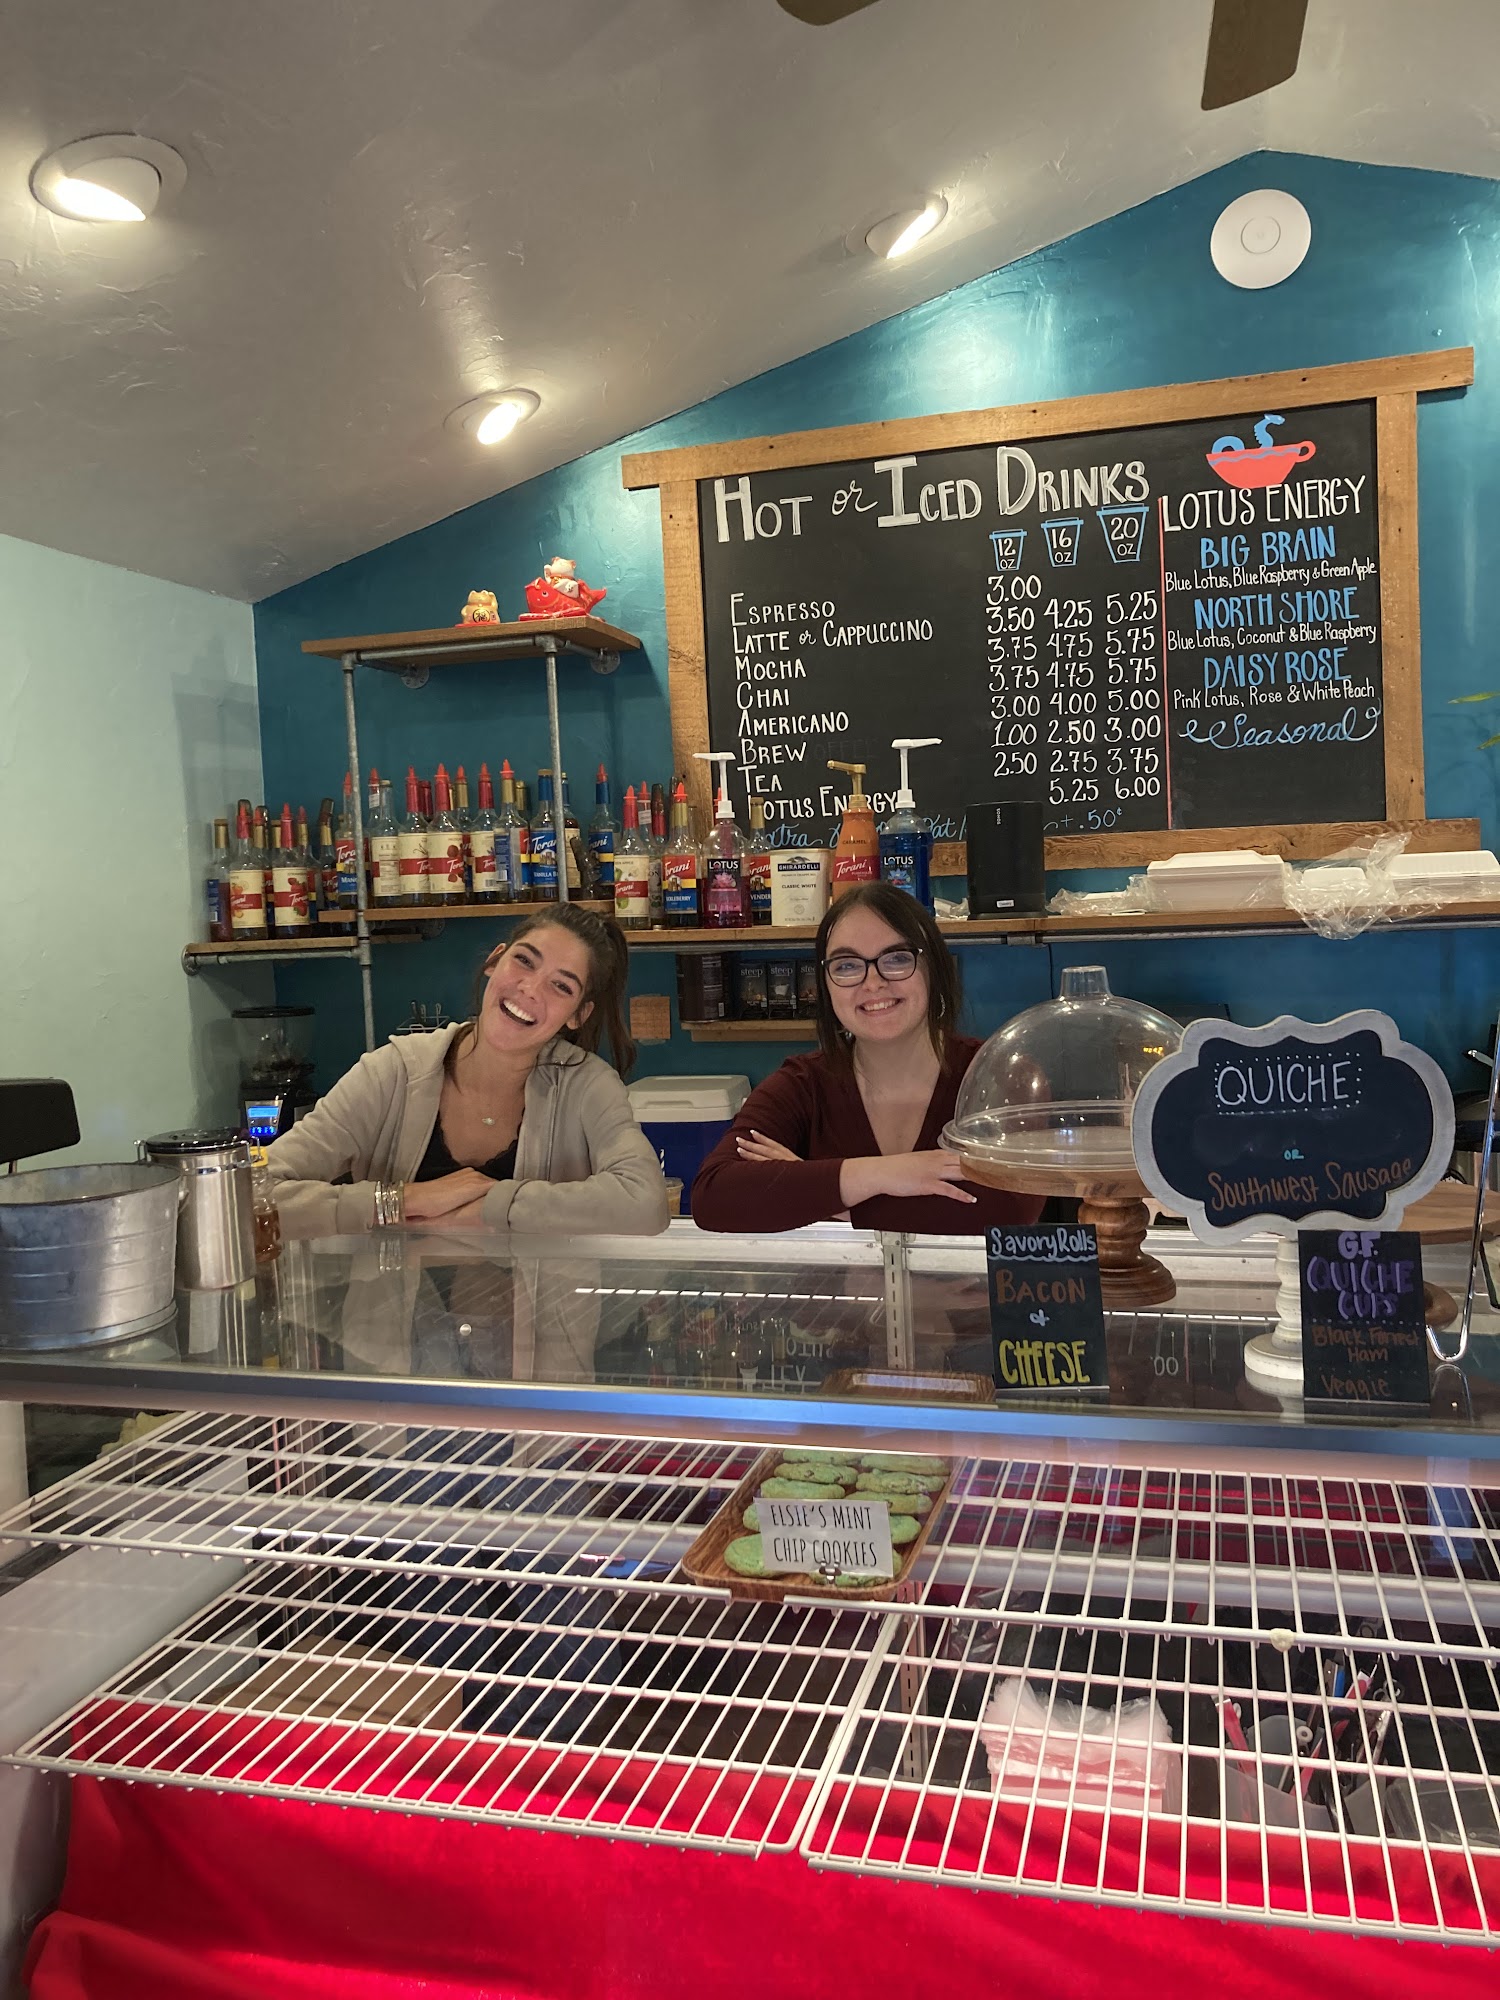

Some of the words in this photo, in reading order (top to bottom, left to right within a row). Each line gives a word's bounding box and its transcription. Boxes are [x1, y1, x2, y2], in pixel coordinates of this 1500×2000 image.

[714, 476, 813, 543] HOT
[831, 480, 879, 515] or
[874, 456, 982, 528] ICED
[996, 446, 1150, 516] DRINKS
[1162, 488, 1255, 532] LOTUS
[1265, 475, 1366, 523] ENERGY
[1052, 528, 1072, 549] 16
[1111, 517, 1139, 540] 20
[998, 538, 1016, 556] 12
[1200, 534, 1250, 569] BIG
[1261, 525, 1336, 566] BRAIN
[986, 574, 1042, 606] 3.00
[1166, 571, 1192, 593] Blue
[1194, 568, 1233, 590] Lotus,
[1233, 566, 1259, 587] Blue
[1259, 562, 1310, 586] Raspberry
[1312, 566, 1321, 579] &
[1321, 560, 1351, 578] Green
[1351, 557, 1378, 581] Apple
[730, 592, 836, 627] ESPRESSO
[986, 606, 1035, 634] 3.50
[1043, 598, 1094, 629] 4.25
[1106, 590, 1158, 625] 5.25
[1194, 593, 1273, 630] NORTH
[1279, 587, 1360, 623] SHORE
[732, 626, 790, 654] LATTE
[799, 629, 817, 645] or
[822, 619, 933, 647] CAPPUCCINO
[987, 635, 1038, 663] 3.75
[1046, 631, 1093, 658] 4.75
[1105, 626, 1155, 655] 5.75
[1168, 630, 1195, 650] Blue
[1197, 628, 1235, 650] Lotus,
[1237, 627, 1286, 645] Coconut
[1289, 627, 1299, 642] &
[1300, 623, 1324, 641] Blue
[1324, 621, 1377, 644] Raspberry
[735, 655, 807, 680] MOCHA
[988, 665, 1040, 692] 3.75
[1046, 661, 1094, 689] 4.75
[1108, 656, 1157, 684] 5.75
[1204, 652, 1278, 689] DAISY
[1285, 647, 1351, 684] ROSE
[736, 681, 790, 710] CHAI
[990, 695, 1041, 719] 3.00
[1049, 692, 1097, 715] 4.00
[1108, 688, 1161, 713] 5.00
[1173, 688, 1201, 710] Pink
[1205, 687, 1244, 708] Lotus,
[1249, 686, 1282, 706] Rose
[1287, 685, 1300, 702] &
[1301, 681, 1341, 700] White
[1343, 677, 1375, 699] Peach
[738, 709, 849, 737] AMERICANO
[990, 721, 1037, 748] 1.00
[1047, 718, 1096, 745] 2.50
[1103, 714, 1161, 743] 3.00
[1180, 704, 1381, 749] Seasonal
[741, 738, 807, 766] BREW
[993, 752, 1038, 778] 2.50
[1050, 749, 1098, 773] 2.75
[1107, 747, 1159, 775] 3.75
[737, 764, 783, 793] TEA
[1049, 778, 1099, 805] 5.25
[1115, 776, 1161, 799] 6.00
[819, 786, 899, 817] ENRGY
[767, 822, 823, 848] xtra
[709, 861, 739, 869] LOTUS
[836, 859, 868, 879] Torani
[883, 856, 914, 866] LOTUS
[1217, 1061, 1352, 1106] QUICHE
[1208, 1172, 1320, 1211] Southwest
[1325, 1157, 1412, 1202] Sausage
[991, 1227, 1058, 1257] Savory
[1056, 1227, 1097, 1252] Rolls
[995, 1268, 1086, 1304] BACON
[1307, 1256, 1414, 1294] QUICHE
[1337, 1289, 1398, 1320] CUPS
[1312, 1325, 1366, 1347] Black
[999, 1339, 1091, 1386] CHEESE
[1347, 1347, 1389, 1363] Ham
[1321, 1374, 1393, 1401] Veggie
[770, 1504, 827, 1528] ELSIE'S
[832, 1505, 872, 1531] MINT
[773, 1537, 807, 1564] CHIP
[813, 1539, 877, 1568] COOKIES
